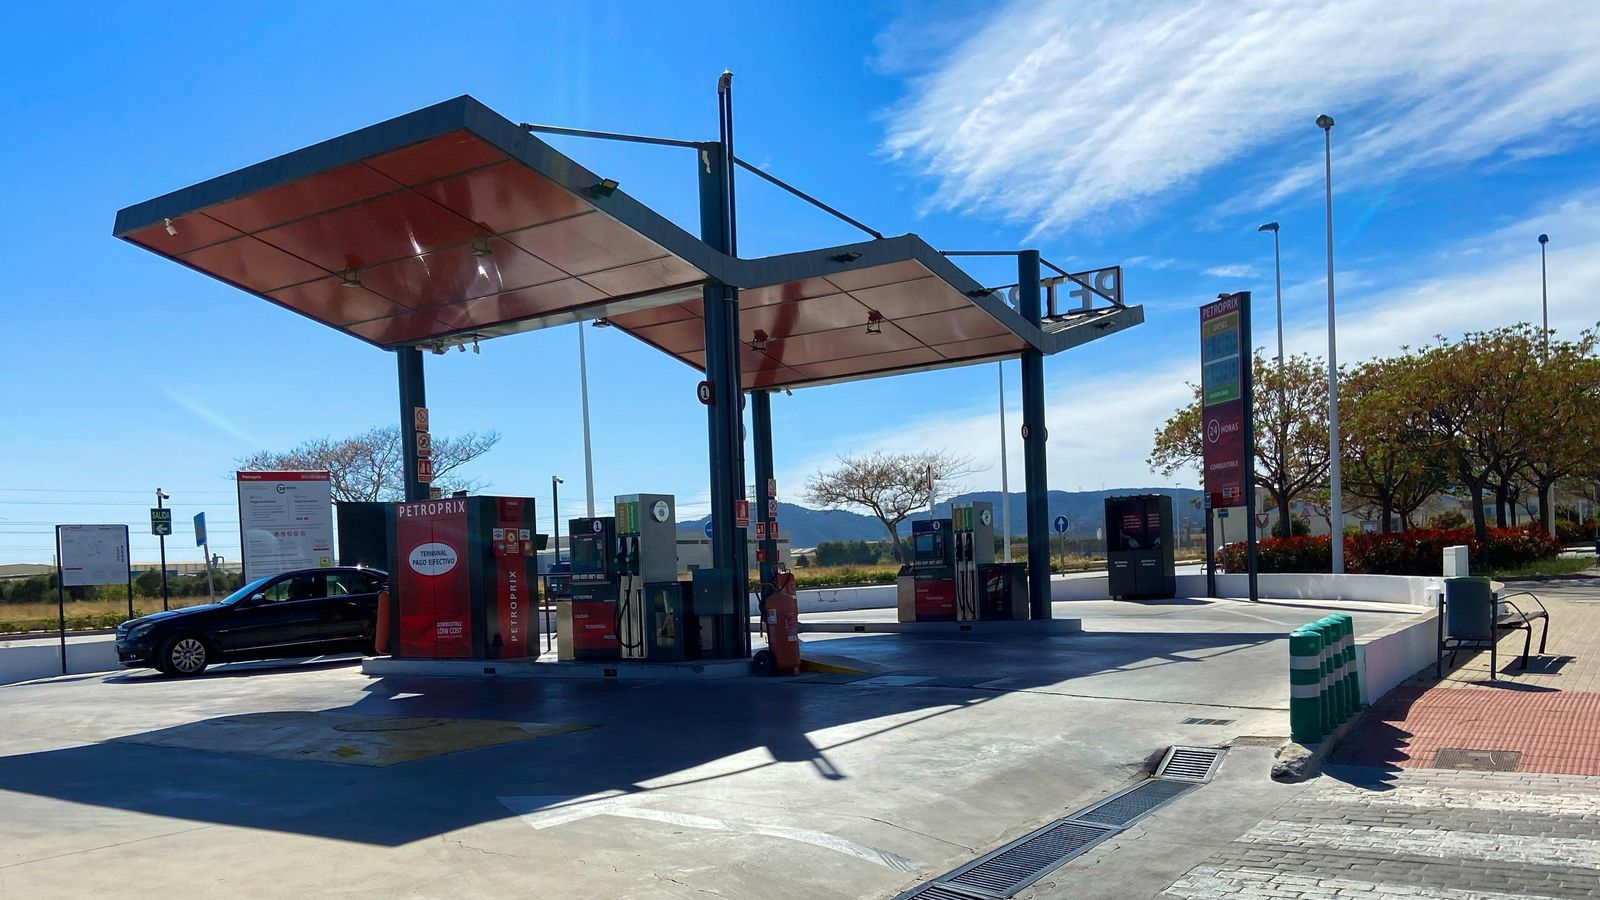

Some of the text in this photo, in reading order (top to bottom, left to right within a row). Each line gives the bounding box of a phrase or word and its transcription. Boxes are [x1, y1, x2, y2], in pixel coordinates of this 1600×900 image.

[1202, 297, 1239, 319] PETROPRIX
[1209, 423, 1239, 437] 24 HORAS
[1210, 460, 1239, 472] COMBUSTIBLE
[151, 511, 170, 520] SALIDA
[399, 501, 465, 518] PETROPRIX
[420, 549, 447, 558] TERMINAL
[428, 558, 455, 566] EFECTIVO
[508, 571, 518, 642] PETROPRIX
[450, 627, 462, 635] COST
